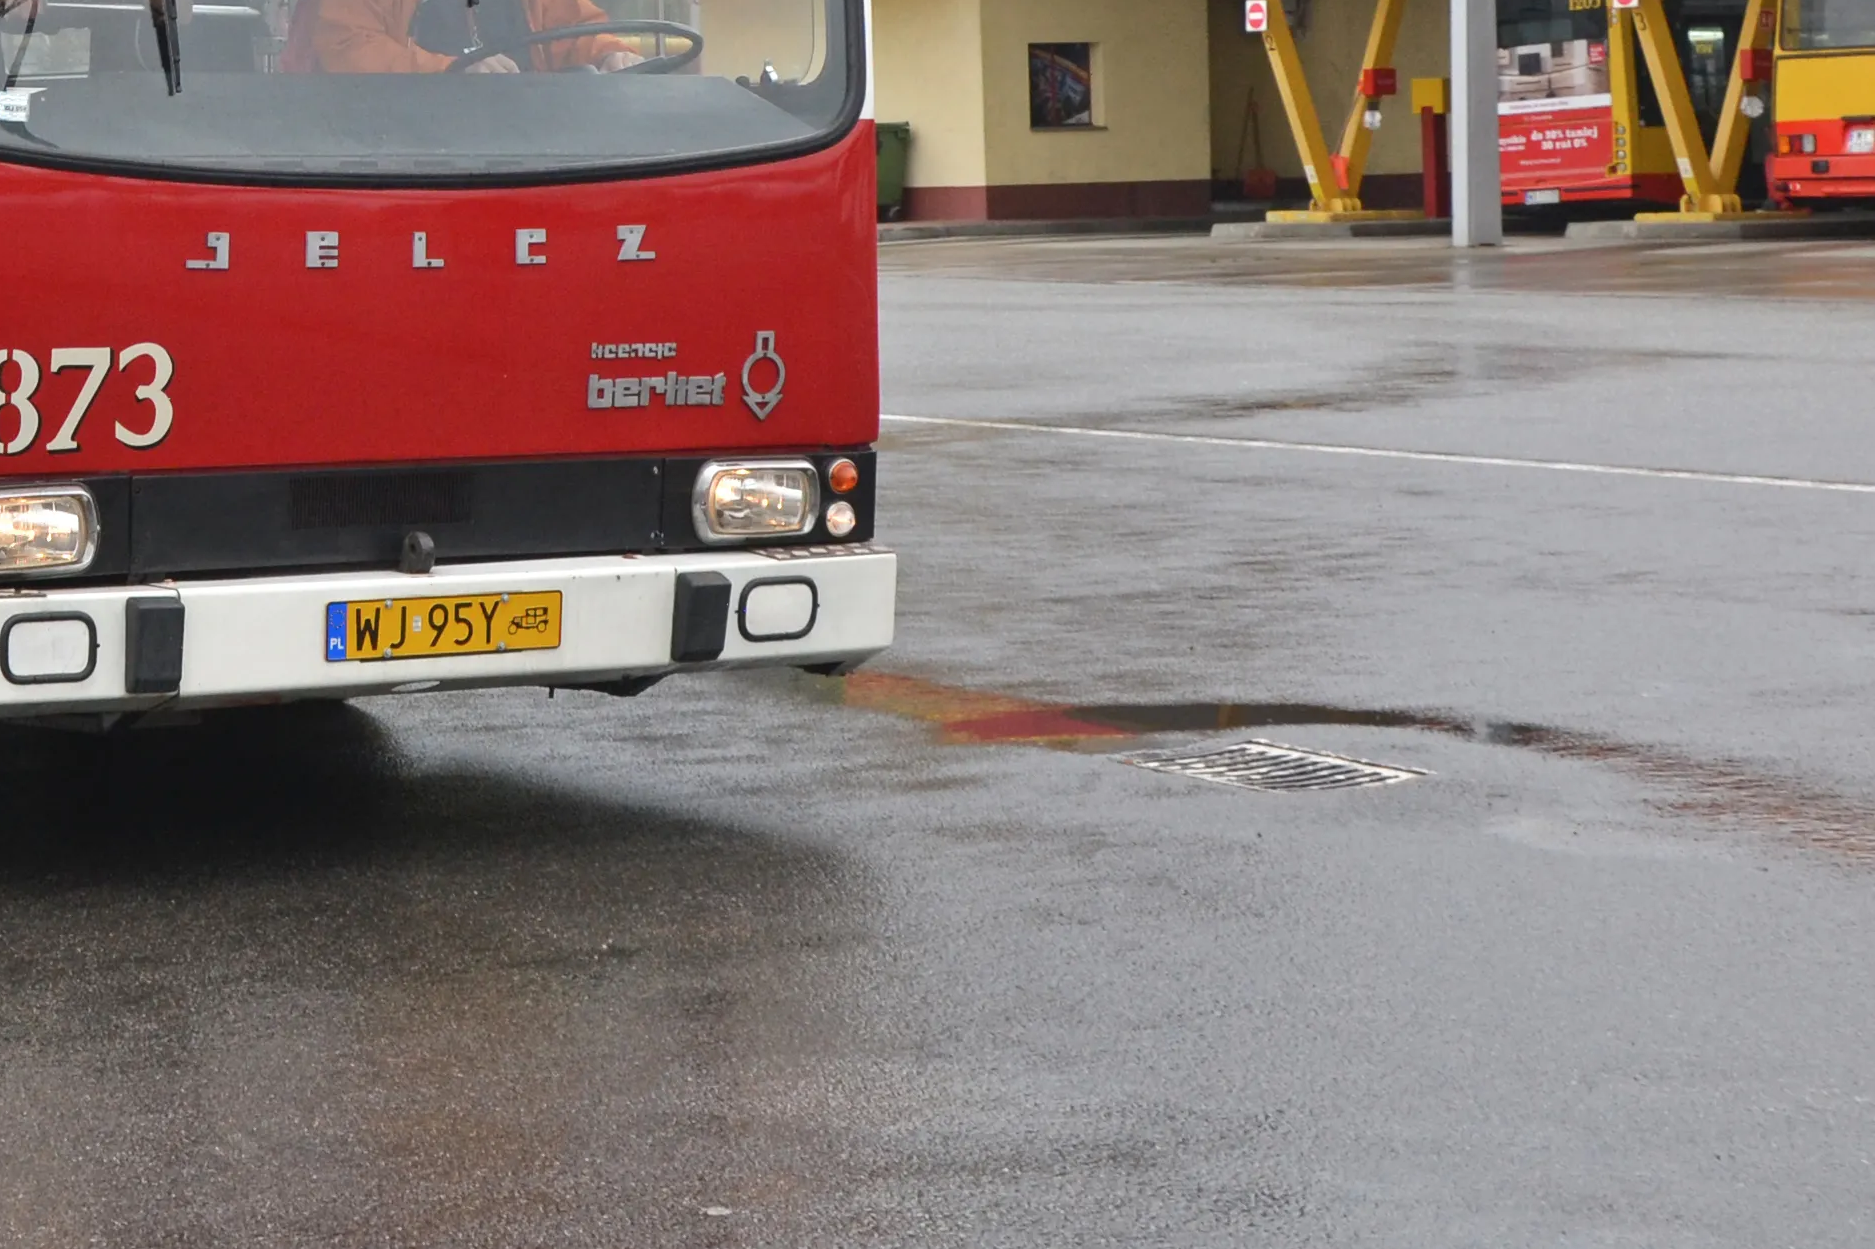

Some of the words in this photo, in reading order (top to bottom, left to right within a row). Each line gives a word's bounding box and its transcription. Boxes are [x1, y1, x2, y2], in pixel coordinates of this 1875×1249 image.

[186, 224, 656, 270] JELCZ
[587, 371, 727, 409] berliet
[330, 637, 344, 650] PL
[356, 606, 407, 652] WJ
[428, 601, 500, 647] 95Y
